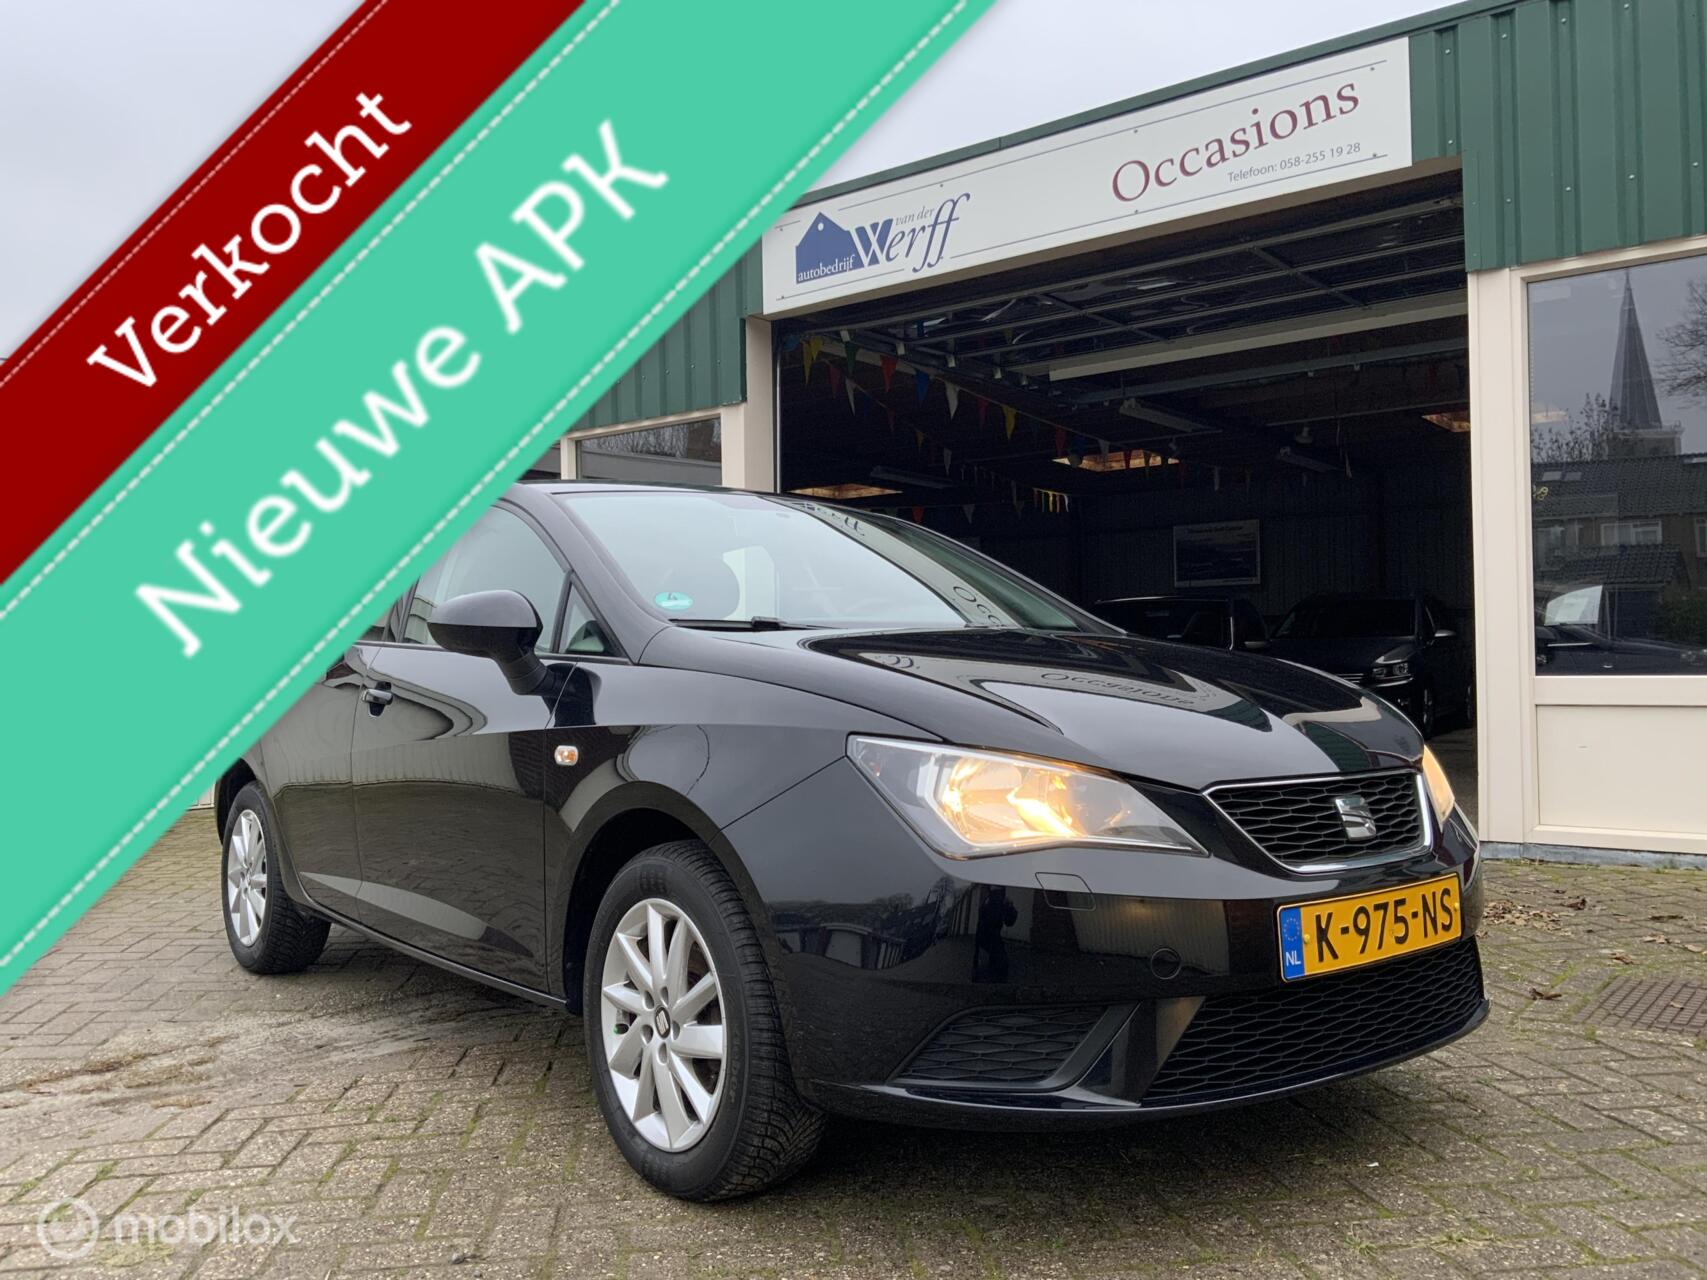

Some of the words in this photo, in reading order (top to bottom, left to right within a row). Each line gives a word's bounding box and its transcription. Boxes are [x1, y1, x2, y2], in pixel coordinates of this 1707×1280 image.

[1111, 83, 1360, 202] Occasions
[1227, 161, 1278, 183] Telefoon:
[1279, 150, 1326, 170] 058-255
[1329, 146, 1344, 158] 19
[1346, 141, 1361, 154] 28
[850, 193, 970, 272] Werff
[895, 213, 915, 226] van
[916, 205, 935, 221] der
[797, 254, 857, 282] autobedrijf
[1315, 887, 1453, 963] K-975-NS
[1285, 951, 1301, 967] NL
